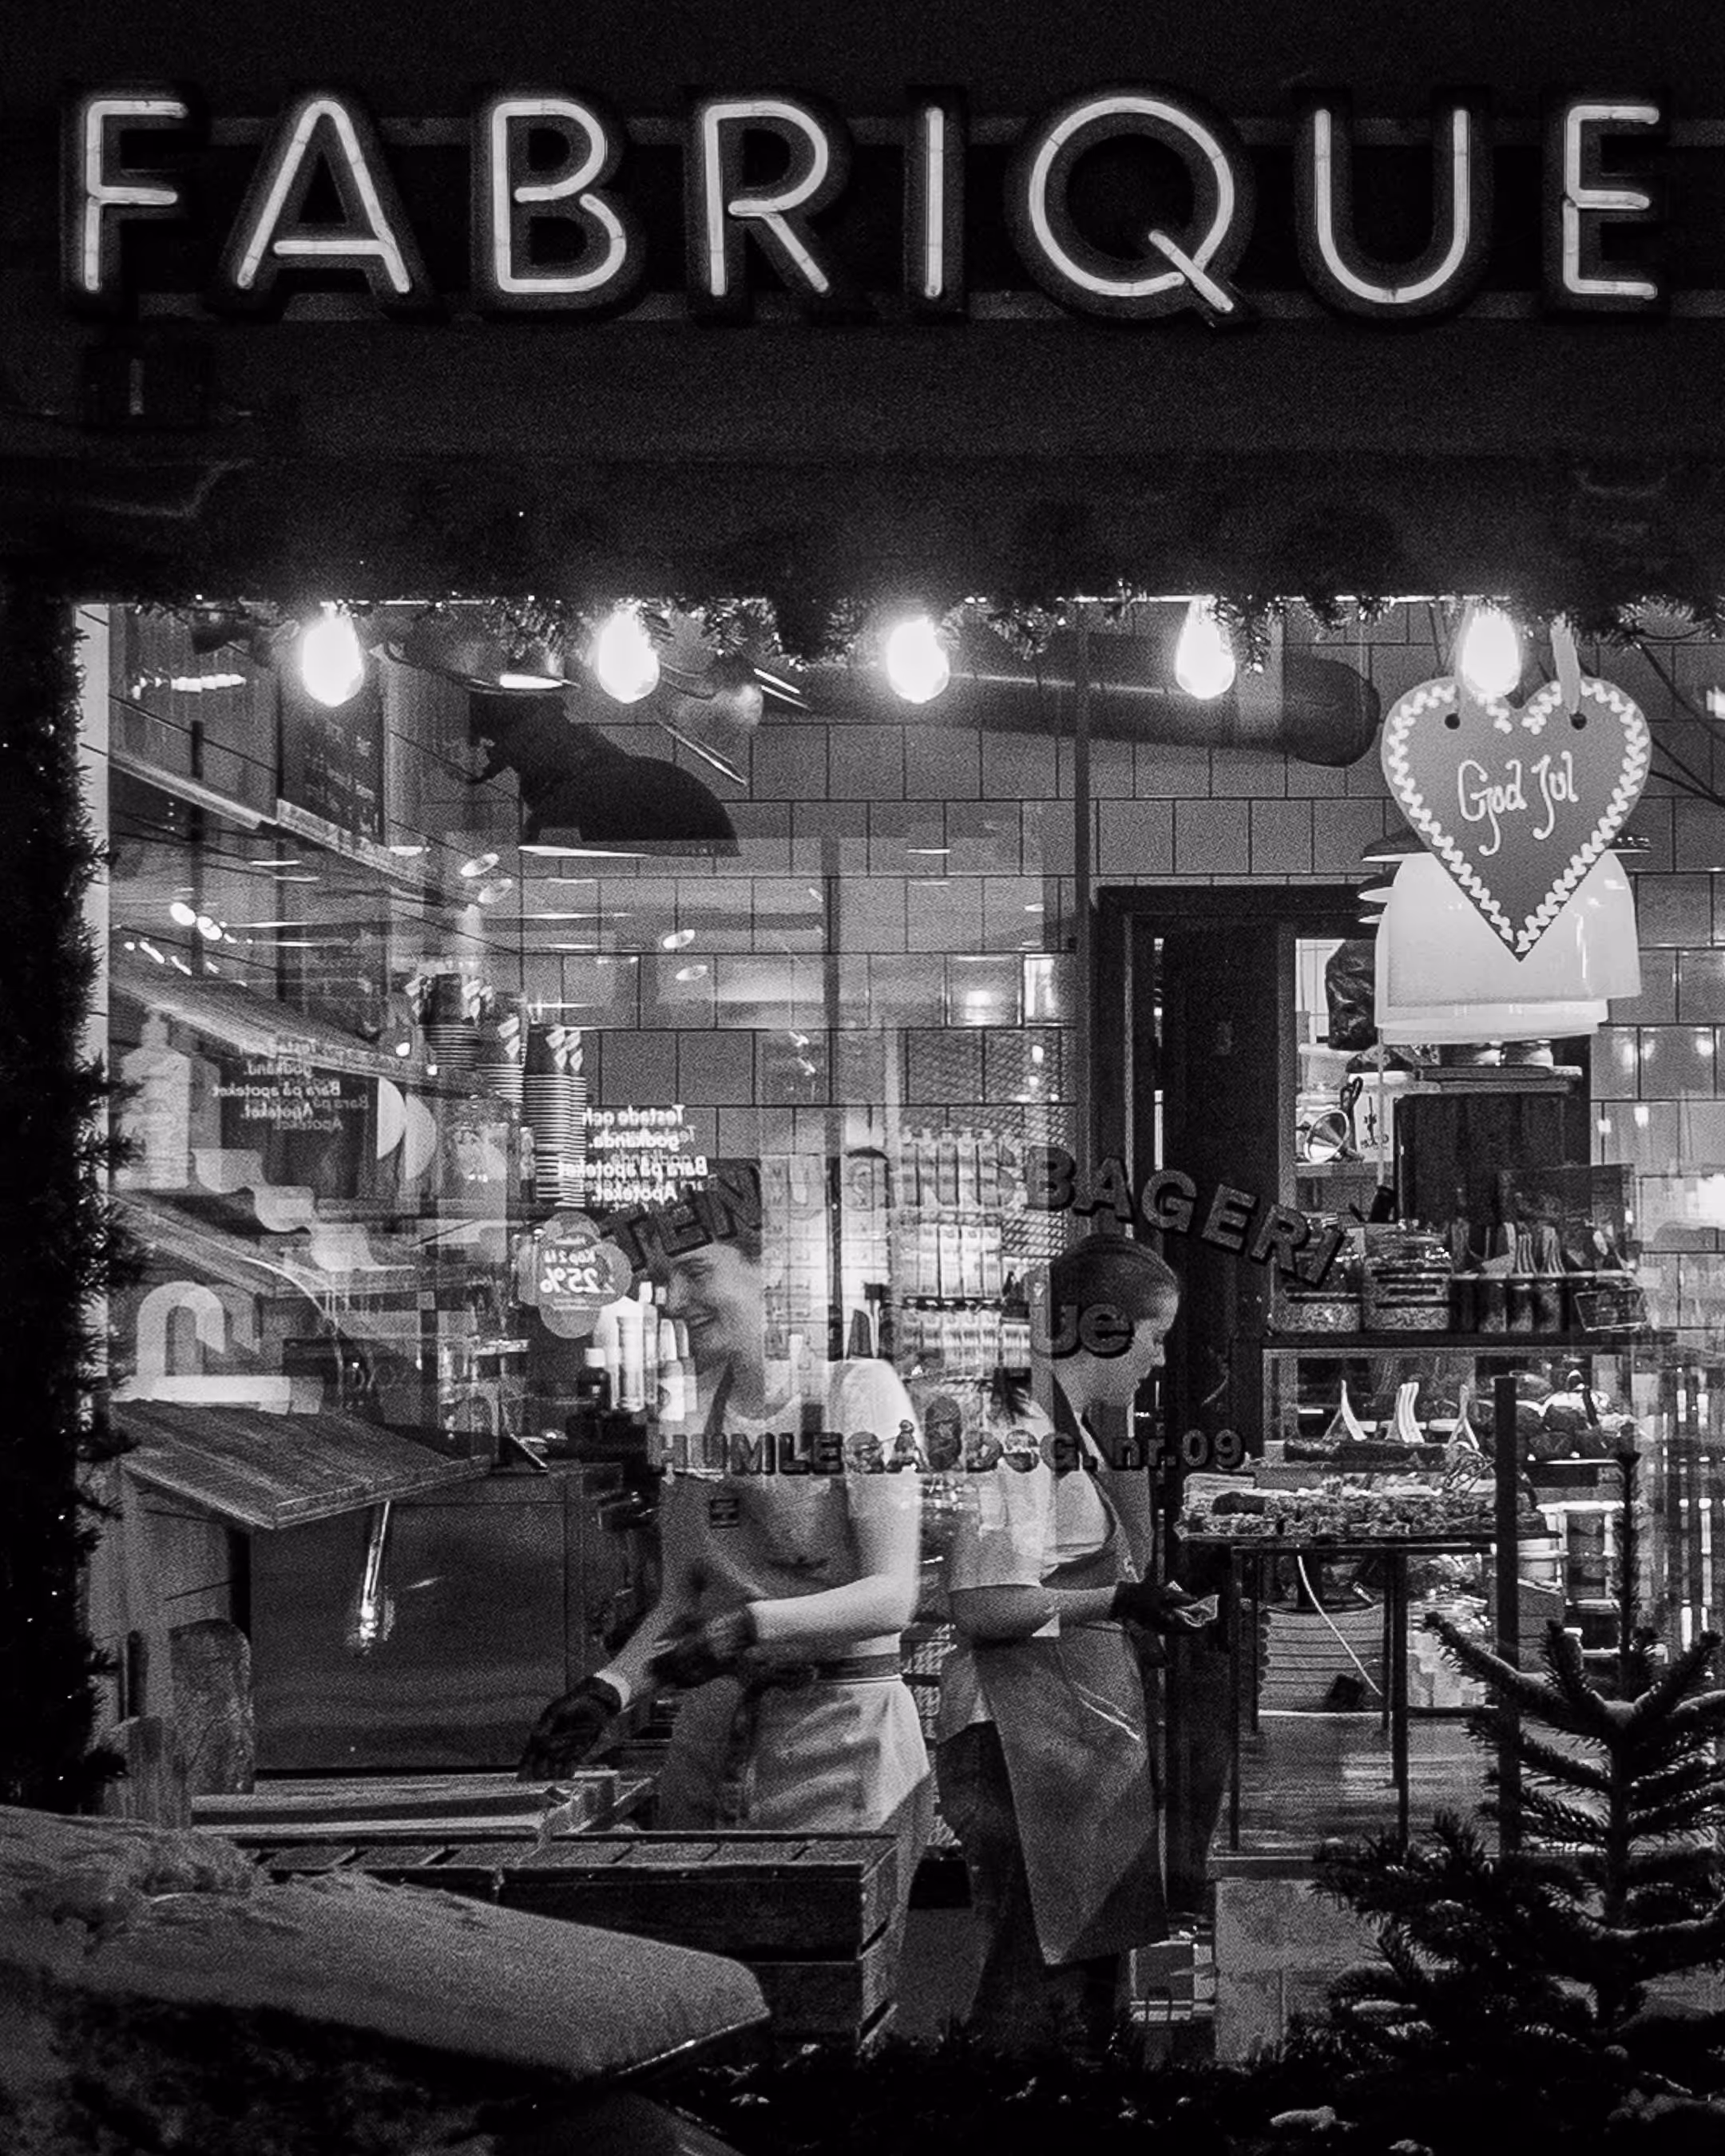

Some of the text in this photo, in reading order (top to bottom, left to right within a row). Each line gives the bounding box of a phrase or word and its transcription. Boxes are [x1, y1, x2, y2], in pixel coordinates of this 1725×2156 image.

[85, 94, 1660, 313] FABRIQUE
[1457, 750, 1579, 857] God Jul
